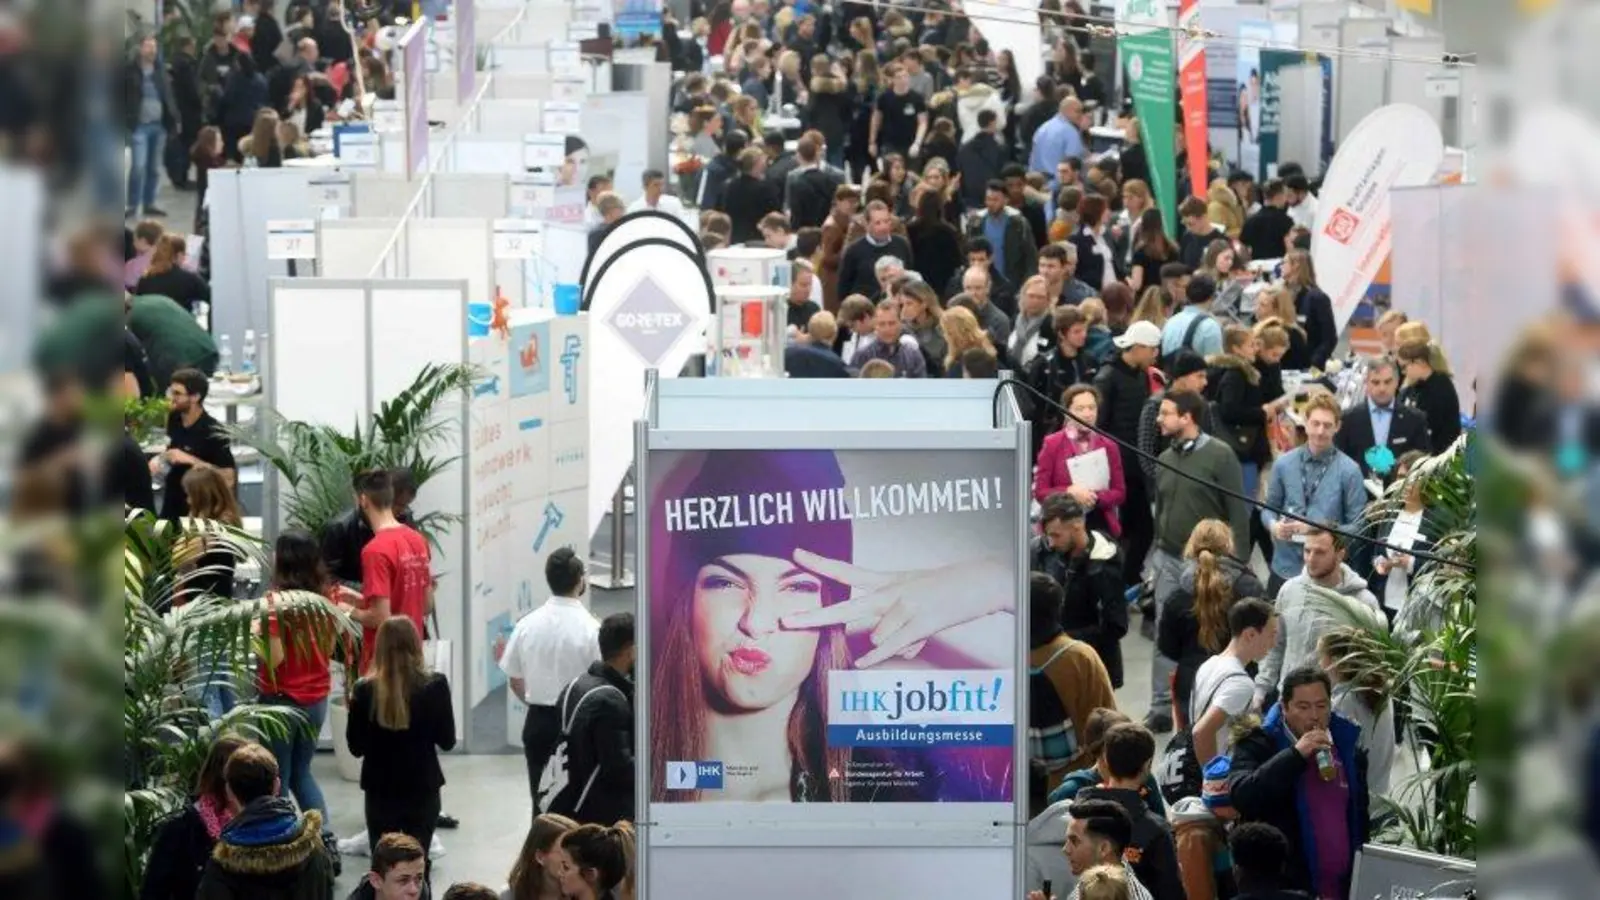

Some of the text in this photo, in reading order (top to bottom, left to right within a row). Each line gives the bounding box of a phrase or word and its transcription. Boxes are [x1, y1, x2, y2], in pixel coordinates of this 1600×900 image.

[664, 477, 1003, 532] HERZLICH WILLKOMMEN!
[856, 729, 983, 744] Ausbildungsmesse
[698, 765, 721, 776] IHK
